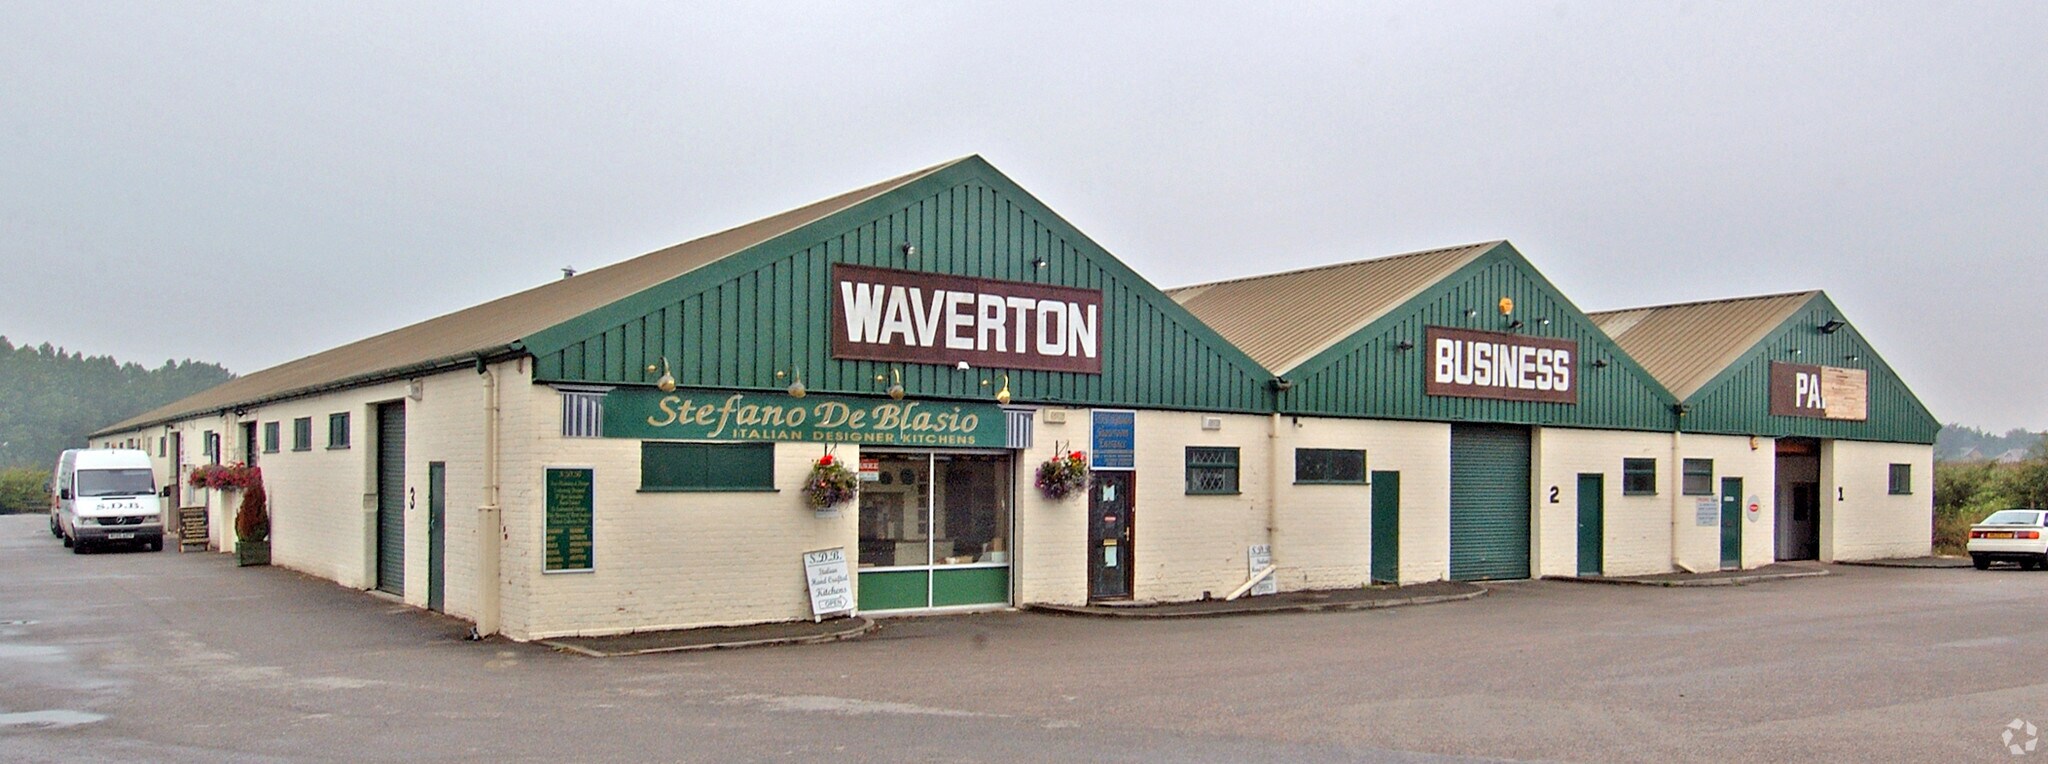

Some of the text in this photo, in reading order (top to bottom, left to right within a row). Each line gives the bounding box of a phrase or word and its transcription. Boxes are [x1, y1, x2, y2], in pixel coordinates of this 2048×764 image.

[841, 281, 1097, 358] WAVERTON
[1435, 338, 1569, 392] BUSINESS
[1795, 372, 1826, 409] PA
[647, 394, 979, 438] Stefano De Blasio
[732, 429, 976, 445] ITALIAN DESIGNER KITCHENS
[410, 487, 416, 510] 3
[1550, 485, 1559, 504] 2
[1838, 486, 1844, 501] 1
[816, 586, 847, 598] Kitchens
